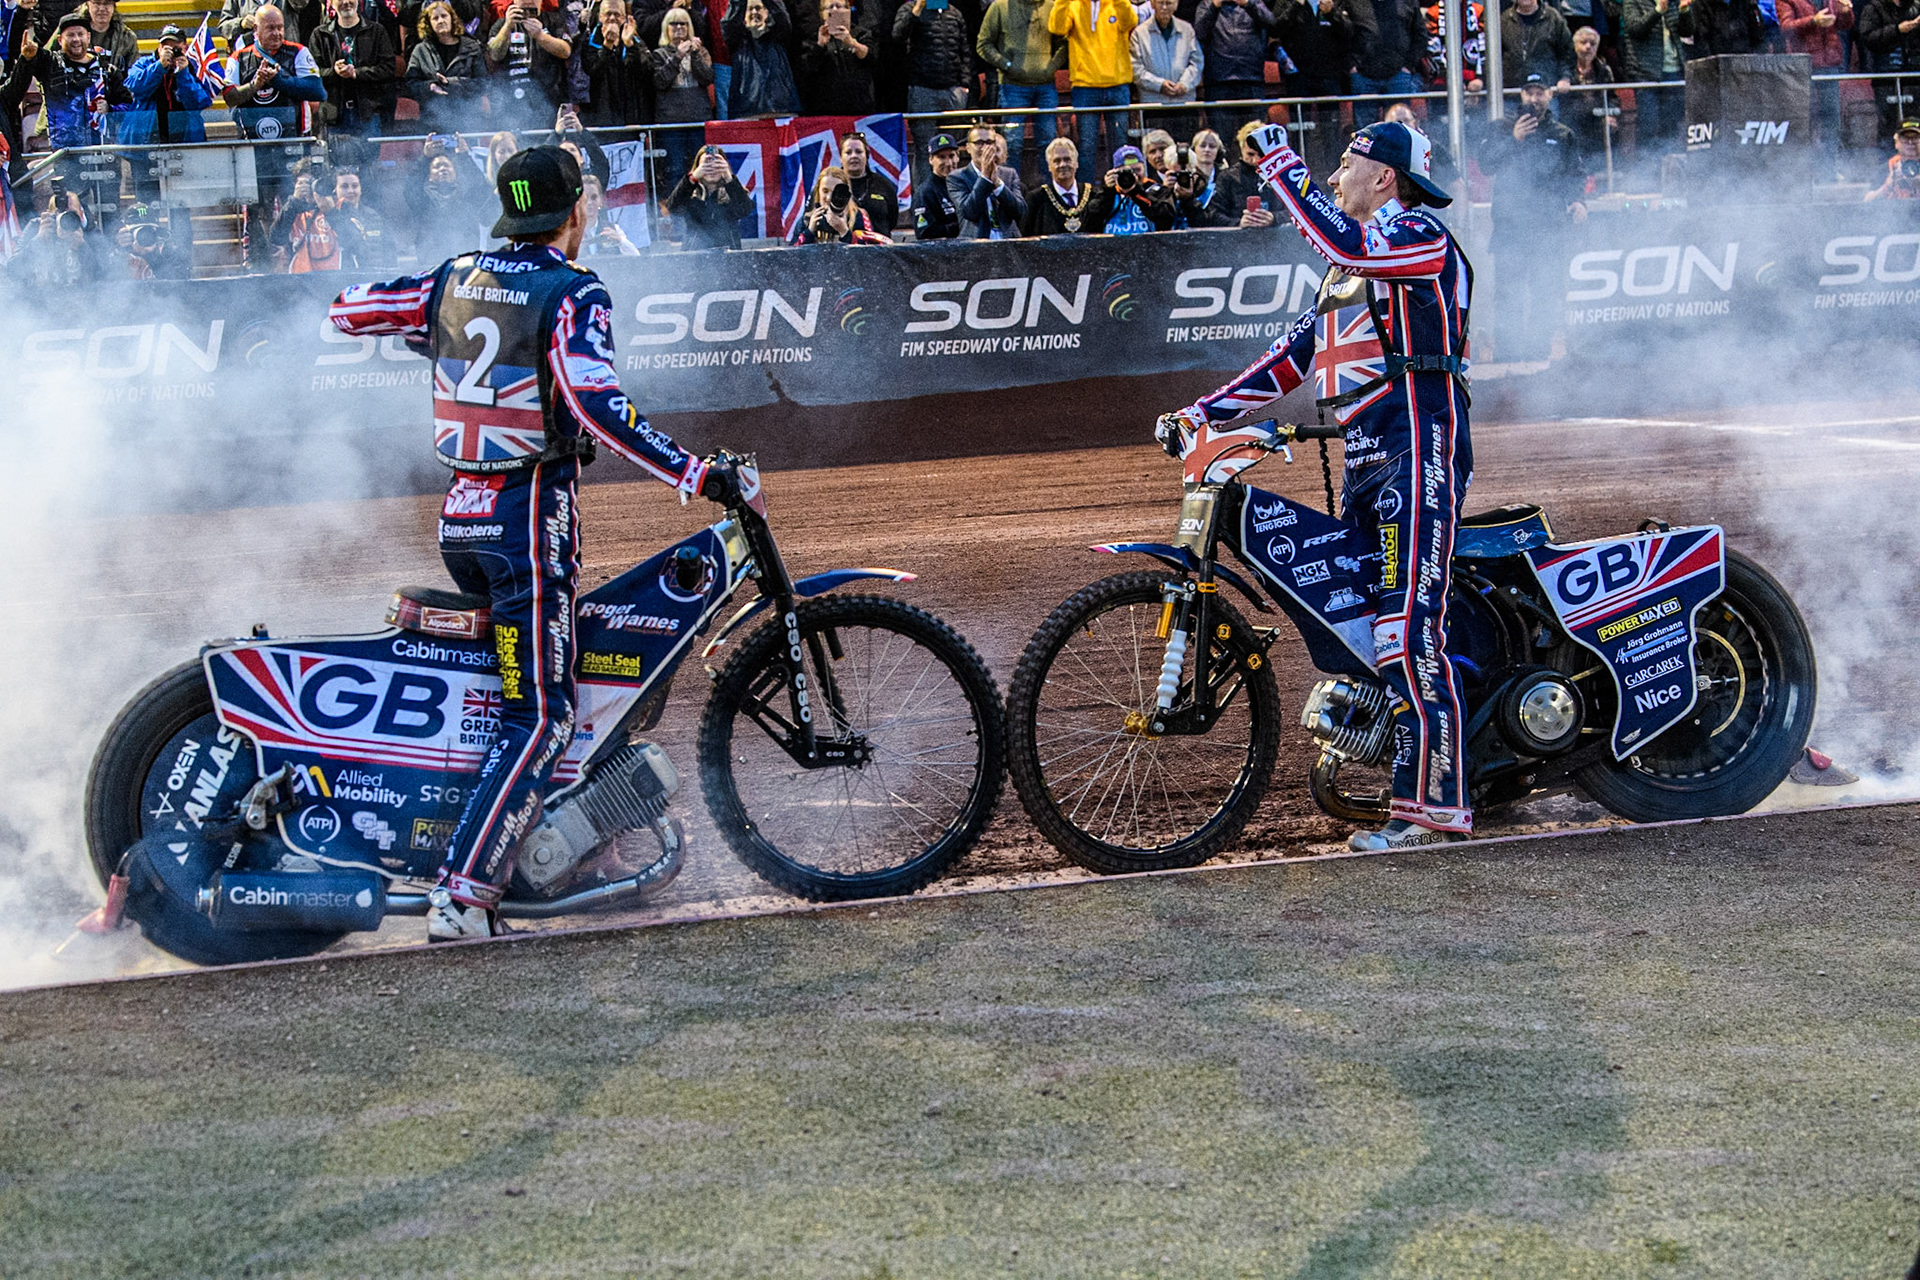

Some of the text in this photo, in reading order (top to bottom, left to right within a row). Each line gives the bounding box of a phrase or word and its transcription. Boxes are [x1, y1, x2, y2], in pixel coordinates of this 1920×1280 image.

[1687, 122, 1713, 144] SON
[1736, 121, 1790, 145] FIM
[1306, 193, 1350, 234] Mobility
[1566, 242, 1740, 301] SON
[1819, 233, 1920, 286] SO
[453, 285, 530, 305] GREAT BRITAIN
[904, 274, 1092, 333] SON
[1814, 293, 1836, 309] FIM
[1838, 290, 1904, 308] SPEEDWAY
[629, 287, 824, 346] SON
[1586, 304, 1654, 323] SPEEDWAY
[1656, 303, 1673, 318] OF
[1675, 300, 1730, 317] NATIONS
[900, 333, 1081, 358] FIM SPEEDWAY OF NATIONS
[1166, 327, 1190, 343] FIM
[1191, 323, 1263, 341] SPEEDWAY
[1265, 322, 1283, 337] OF
[20, 319, 225, 384] SON
[455, 316, 501, 406] 2
[626, 346, 812, 370] FIM SPEEDWAY OF NATIONS
[153, 382, 215, 401] NATIONS
[312, 369, 432, 391] FIM SPEEDWAY O
[1345, 436, 1380, 453] obility
[1432, 423, 1446, 484] Warnes
[481, 462, 491, 471] OF
[492, 460, 523, 470] NATIONS
[444, 477, 499, 515] STAR
[465, 480, 489, 489] DAILY
[1424, 461, 1439, 510] Roger
[555, 488, 569, 541] Roger
[1180, 518, 1205, 531] SON
[443, 524, 504, 538] Silkolene
[1302, 528, 1350, 549] RFX
[546, 516, 565, 577] Warnes
[1272, 543, 1291, 556] ATPI
[1385, 527, 1395, 586] POWER
[1430, 518, 1442, 581] Warnes
[1294, 561, 1330, 579] NGK
[1417, 557, 1430, 607] Roger
[1557, 543, 1640, 606] GB
[557, 591, 570, 643] Roger
[579, 601, 636, 620] Roger
[606, 613, 680, 631] Warnes
[1600, 600, 1678, 640] POWER MAXED
[503, 626, 519, 668] Steel
[1422, 616, 1440, 675] Warnes
[1627, 621, 1684, 650] Jörg Grohmann
[1631, 634, 1689, 663] Insurance Broker
[391, 638, 498, 668] Cabinmaste
[549, 619, 565, 683] Warnes
[583, 651, 641, 668] Steel Seal
[1415, 655, 1438, 703] Roger
[1624, 654, 1684, 687] GARCAREK
[300, 663, 450, 739] GB
[1634, 684, 1682, 714] Nice
[460, 718, 502, 733] GREA
[460, 733, 500, 747] BRITA
[532, 721, 562, 778] Warnes
[1438, 711, 1452, 774] Warnes
[336, 769, 383, 787] Allied
[1429, 749, 1444, 803] Roger
[333, 785, 408, 809] Mobility
[419, 785, 461, 804] SRG
[305, 816, 334, 831] ATPI
[514, 790, 539, 842] Roger
[485, 812, 519, 876] Warnes
[229, 885, 353, 907] Cabinmaster
